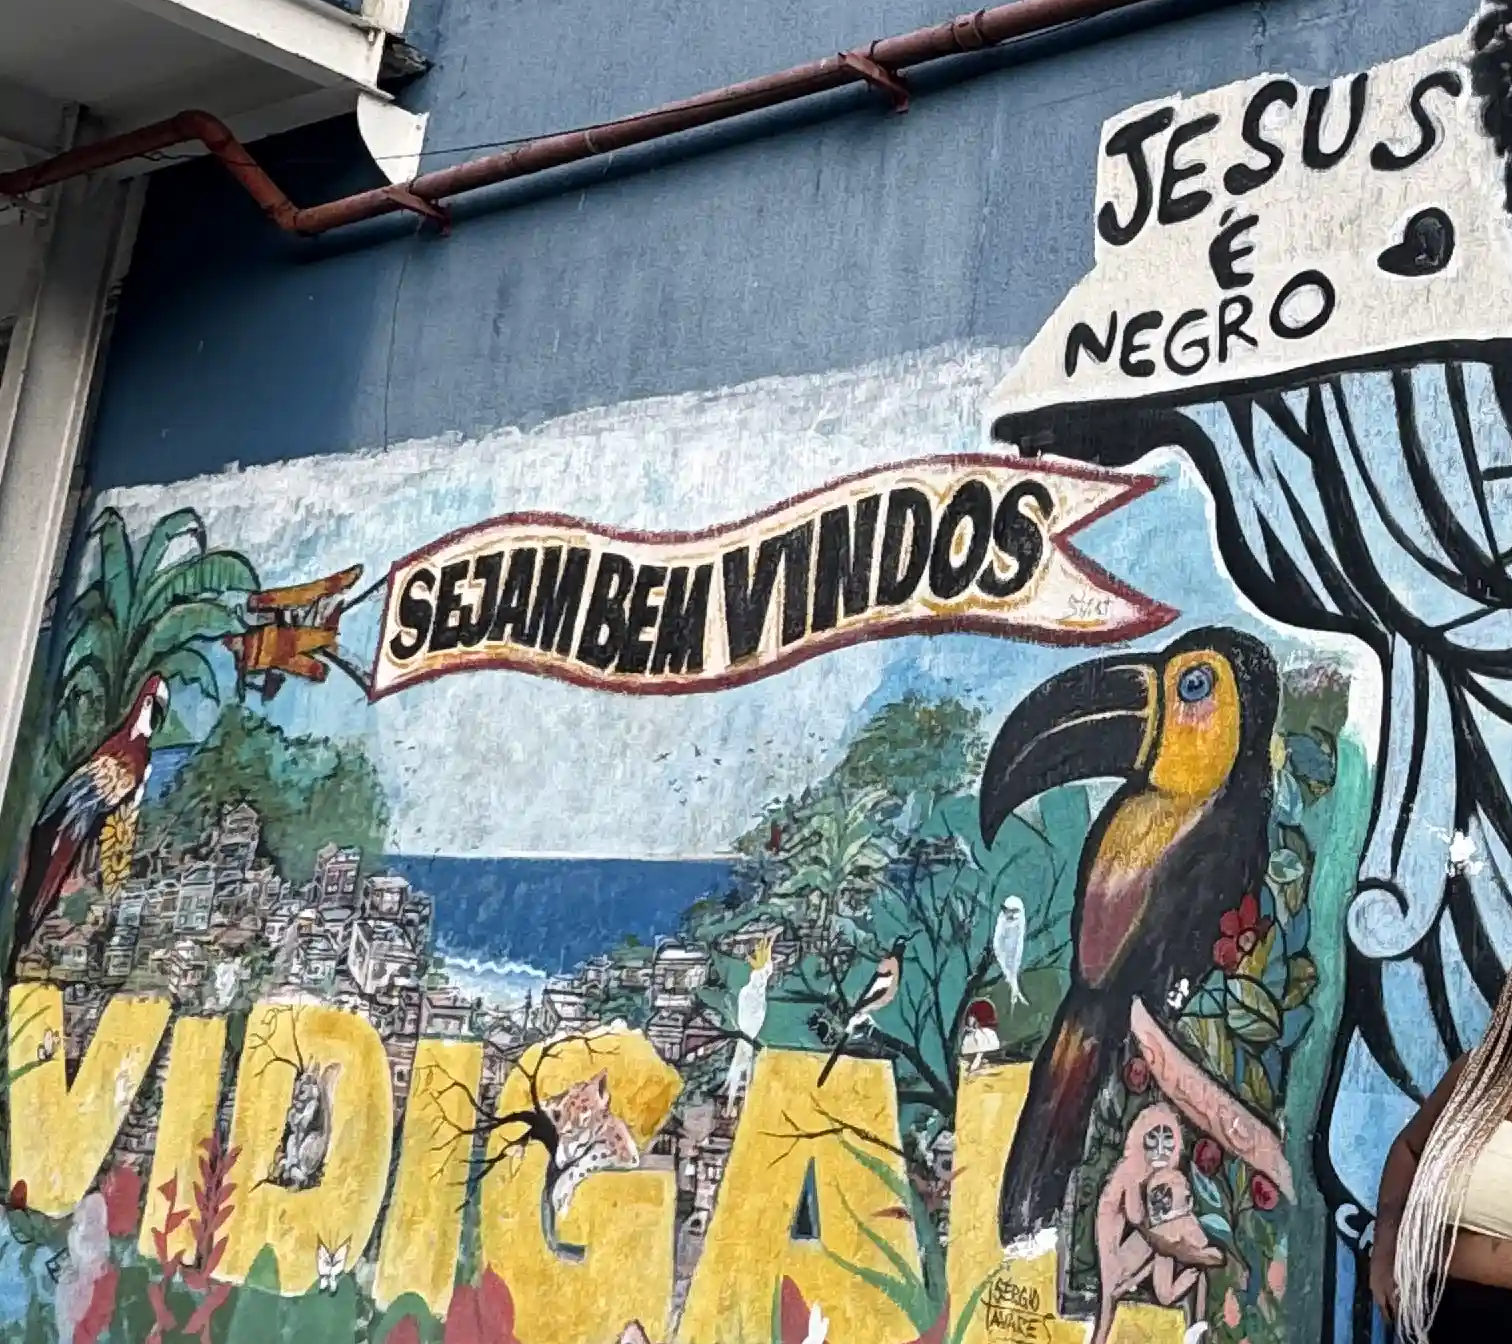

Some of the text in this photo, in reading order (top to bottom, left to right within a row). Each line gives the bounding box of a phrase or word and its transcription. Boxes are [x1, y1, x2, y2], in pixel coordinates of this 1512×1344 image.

[1097, 67, 1466, 247] JESUS
[1208, 205, 1260, 291] É
[1064, 268, 1336, 378] NEGRO
[389, 478, 1054, 676] SEJAM BEM VINDOS
